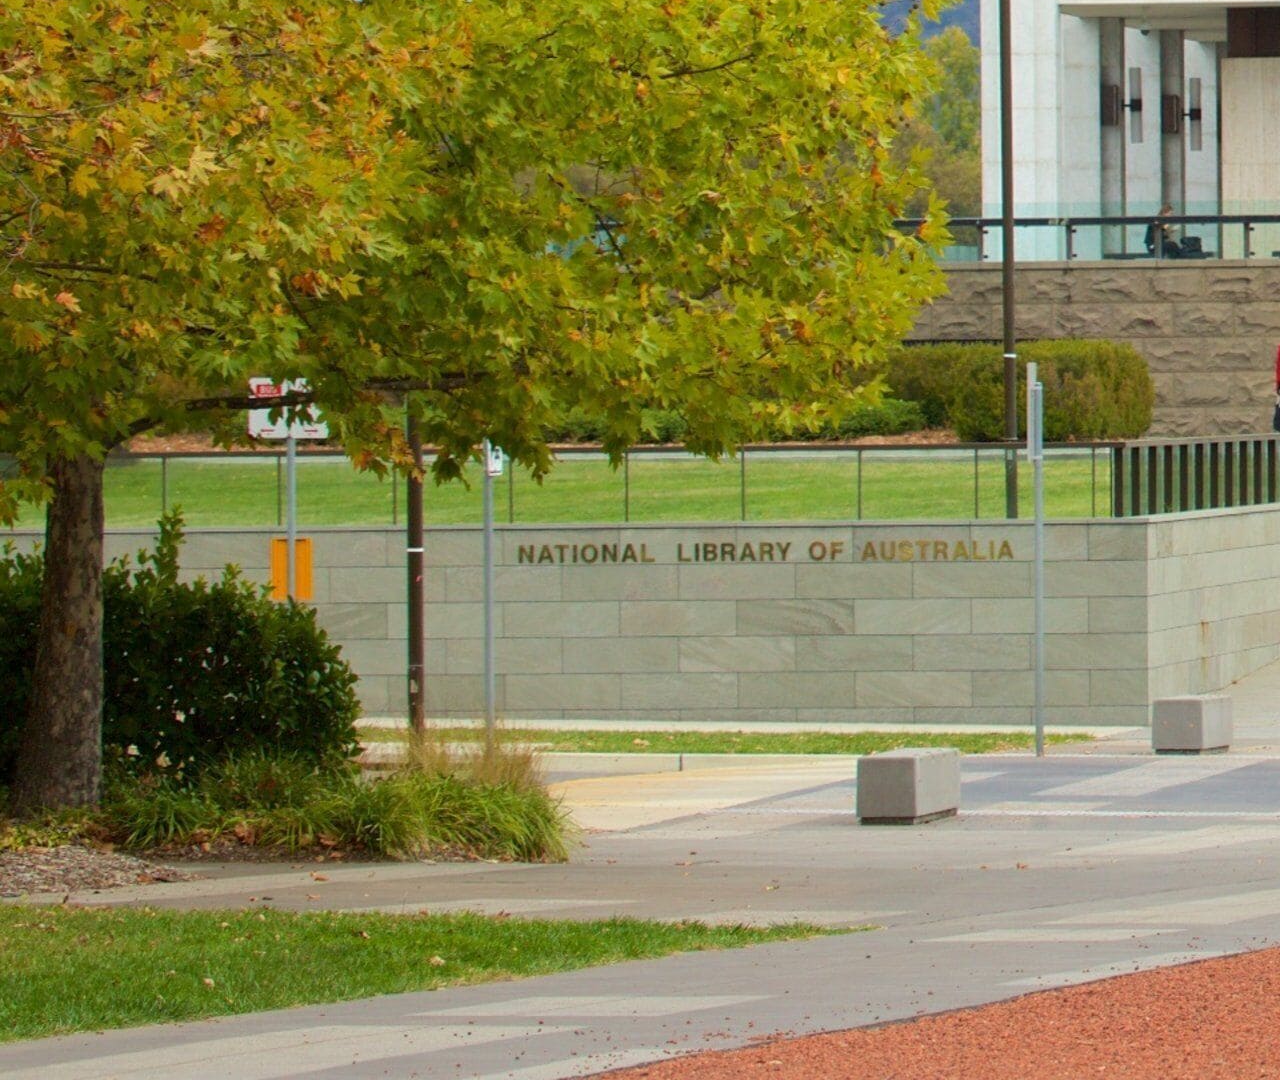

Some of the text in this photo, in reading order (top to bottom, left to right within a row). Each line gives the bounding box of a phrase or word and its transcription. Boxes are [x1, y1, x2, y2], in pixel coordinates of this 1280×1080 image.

[518, 539, 1014, 564] NATIONAL LIBRARY OF AUSTRALIA
